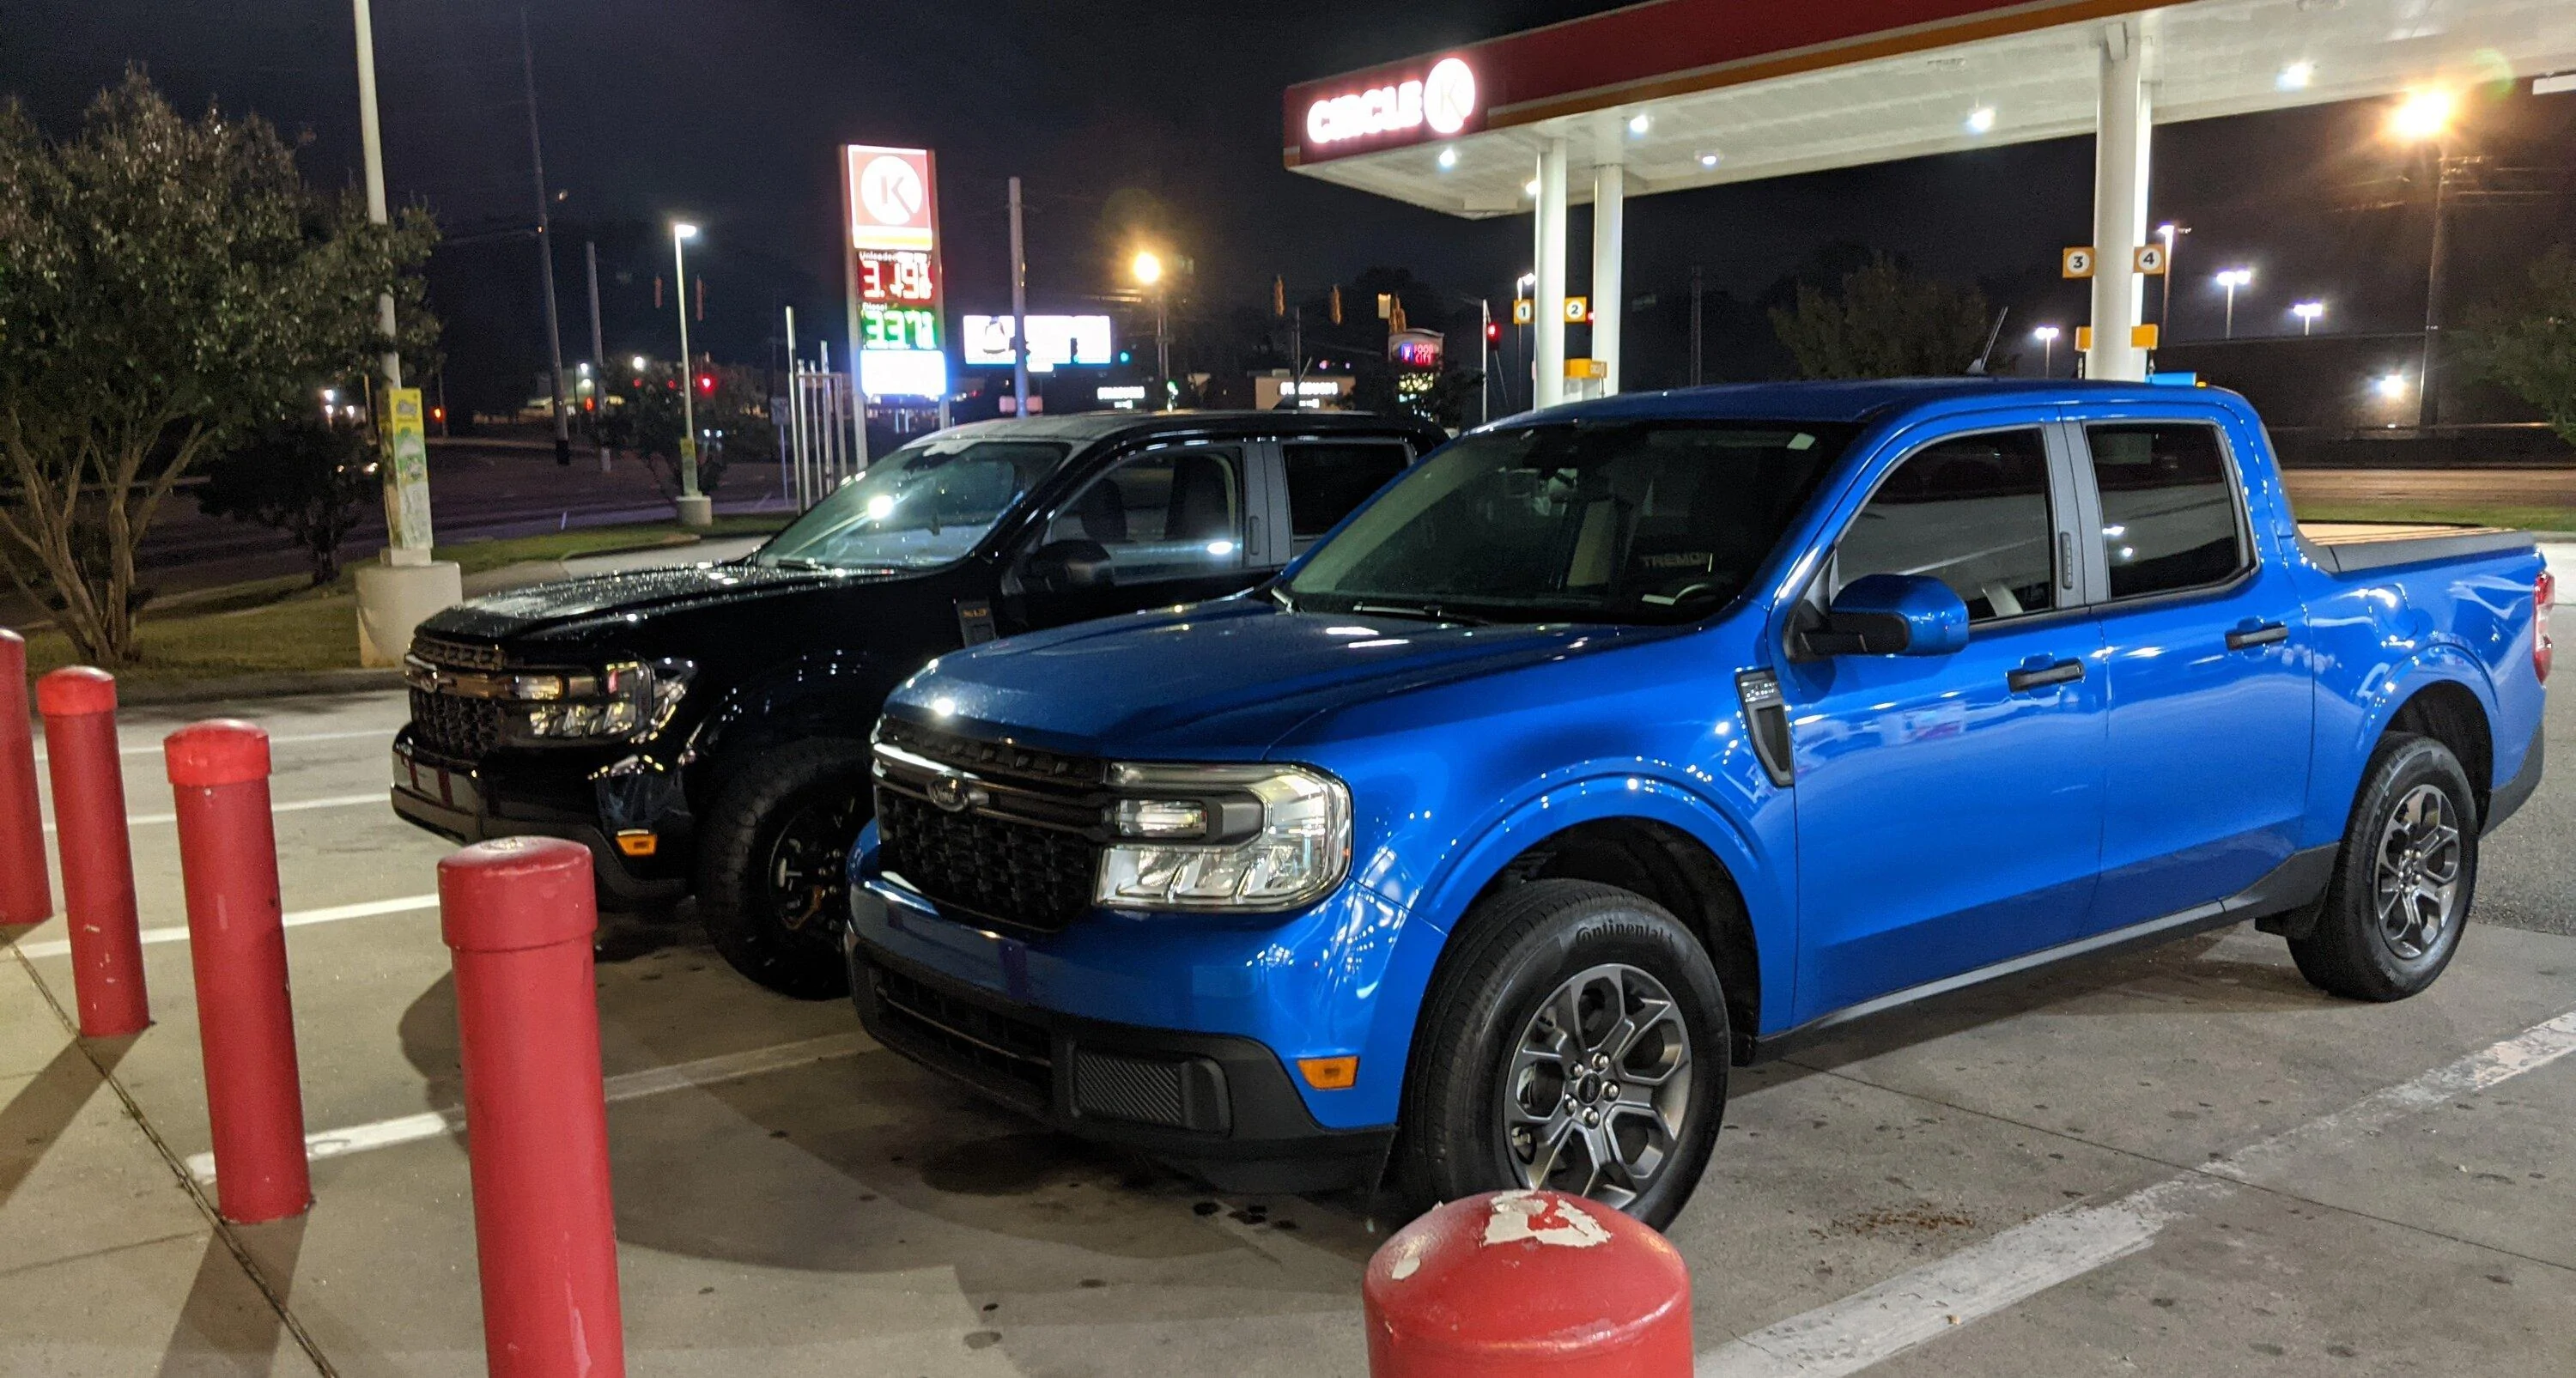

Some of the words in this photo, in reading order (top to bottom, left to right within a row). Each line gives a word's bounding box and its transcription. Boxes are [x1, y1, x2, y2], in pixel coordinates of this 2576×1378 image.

[1308, 81, 1422, 143] CIRCLE
[881, 174, 915, 217] K
[2073, 256, 2083, 269] 3
[2143, 252, 2154, 264] 4
[1522, 307, 1527, 317] 1
[1571, 304, 1579, 315] 2
[1575, 918, 1664, 945] Continental
